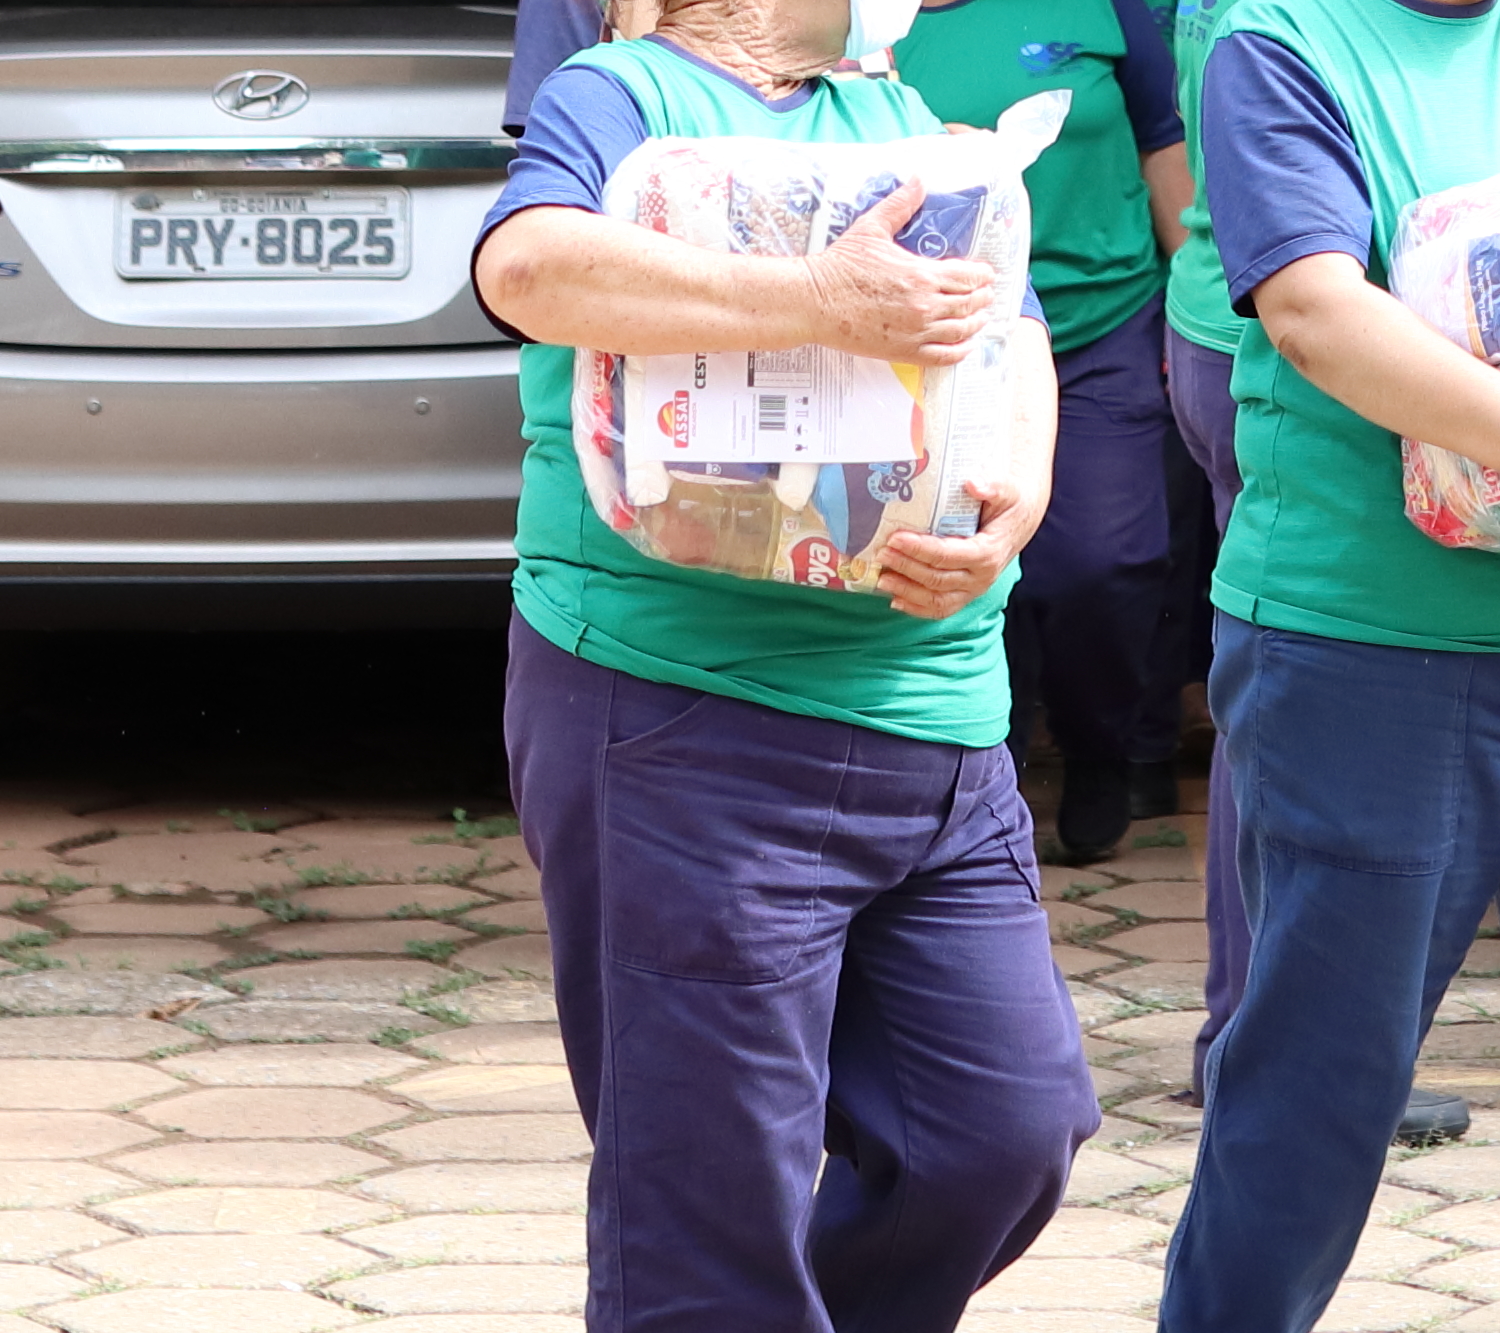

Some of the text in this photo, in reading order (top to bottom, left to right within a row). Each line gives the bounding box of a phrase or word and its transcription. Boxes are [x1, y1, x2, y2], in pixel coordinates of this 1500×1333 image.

[695, 352, 707, 389] CEST
[674, 395, 689, 444] ASSAÍ
[807, 542, 837, 589] oya
